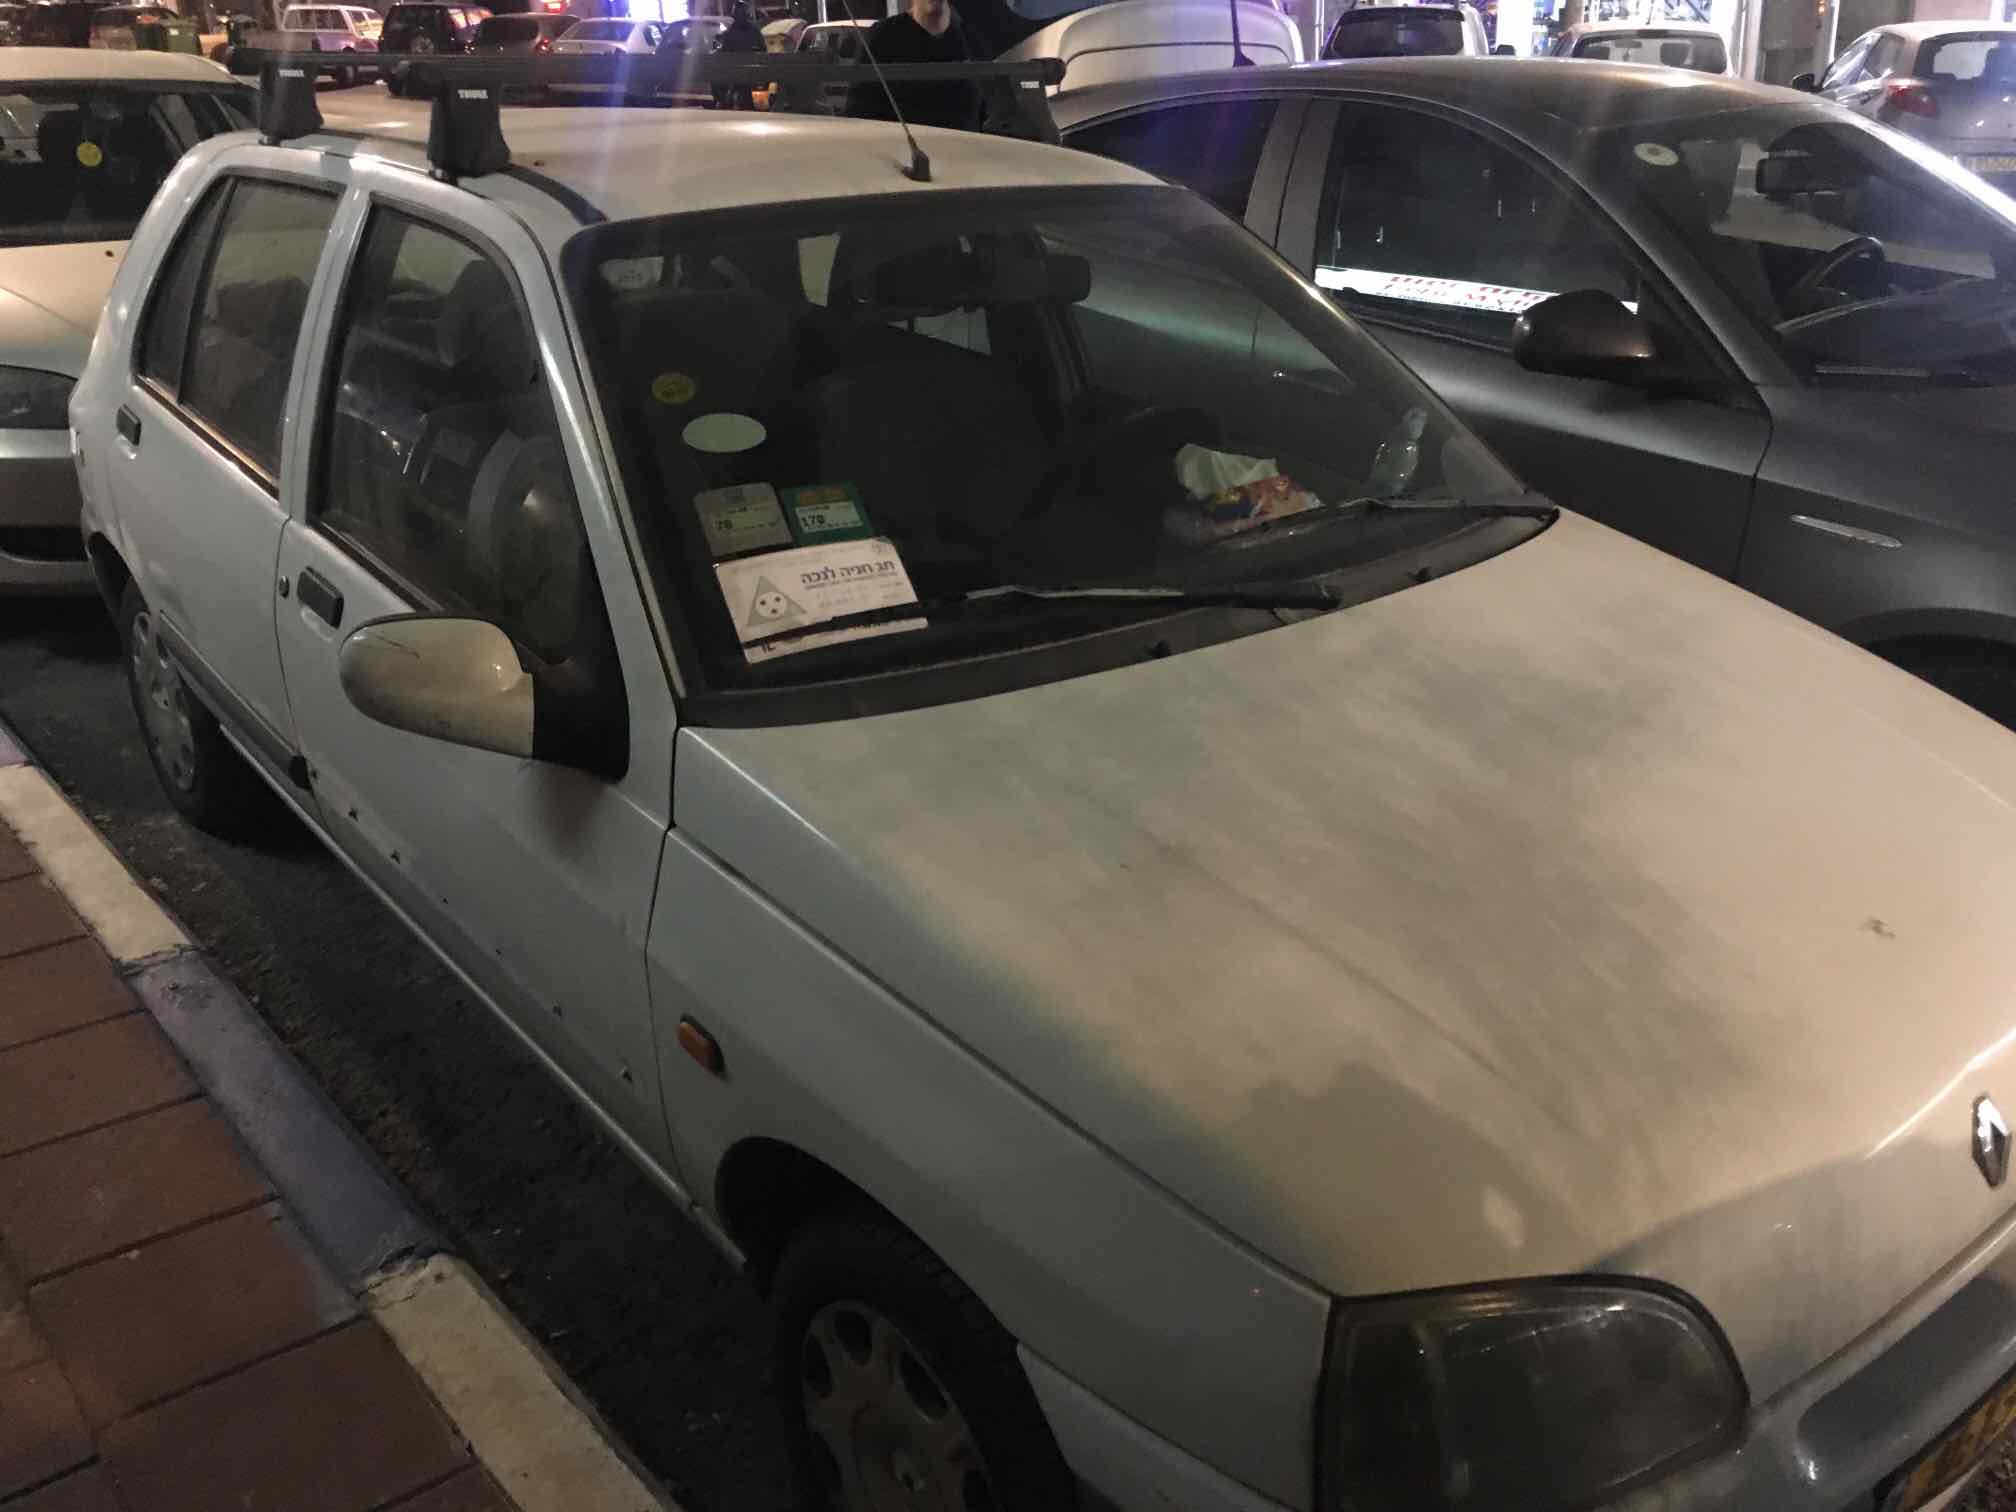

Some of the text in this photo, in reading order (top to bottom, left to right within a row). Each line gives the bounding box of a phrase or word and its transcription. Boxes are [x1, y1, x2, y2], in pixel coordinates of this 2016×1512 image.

[838, 563, 873, 577] חניה
[874, 560, 895, 571] תג
[800, 566, 837, 584] לנכה
